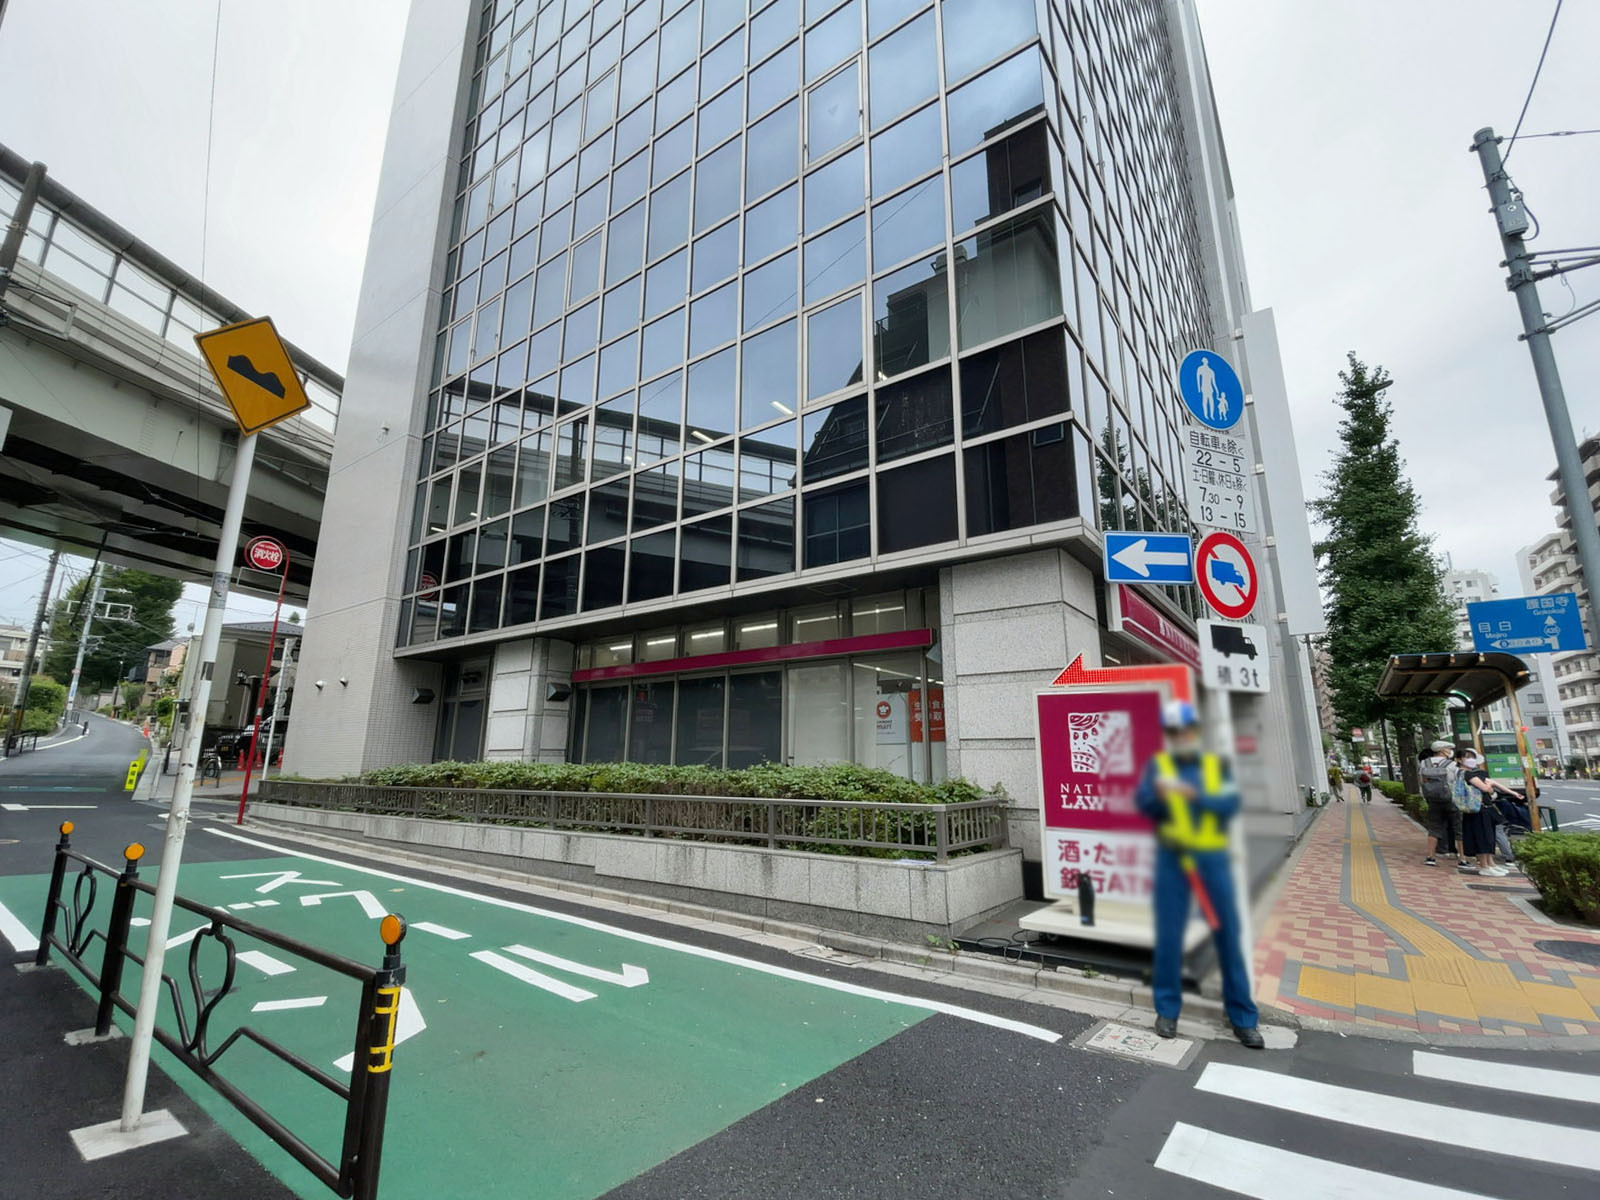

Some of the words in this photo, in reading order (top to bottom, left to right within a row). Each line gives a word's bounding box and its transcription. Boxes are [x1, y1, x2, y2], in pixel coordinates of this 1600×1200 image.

[1189, 430, 1244, 456] 自転車を除く
[254, 547, 279, 562] 消火栓
[1060, 867, 1154, 894] 銀行AT
